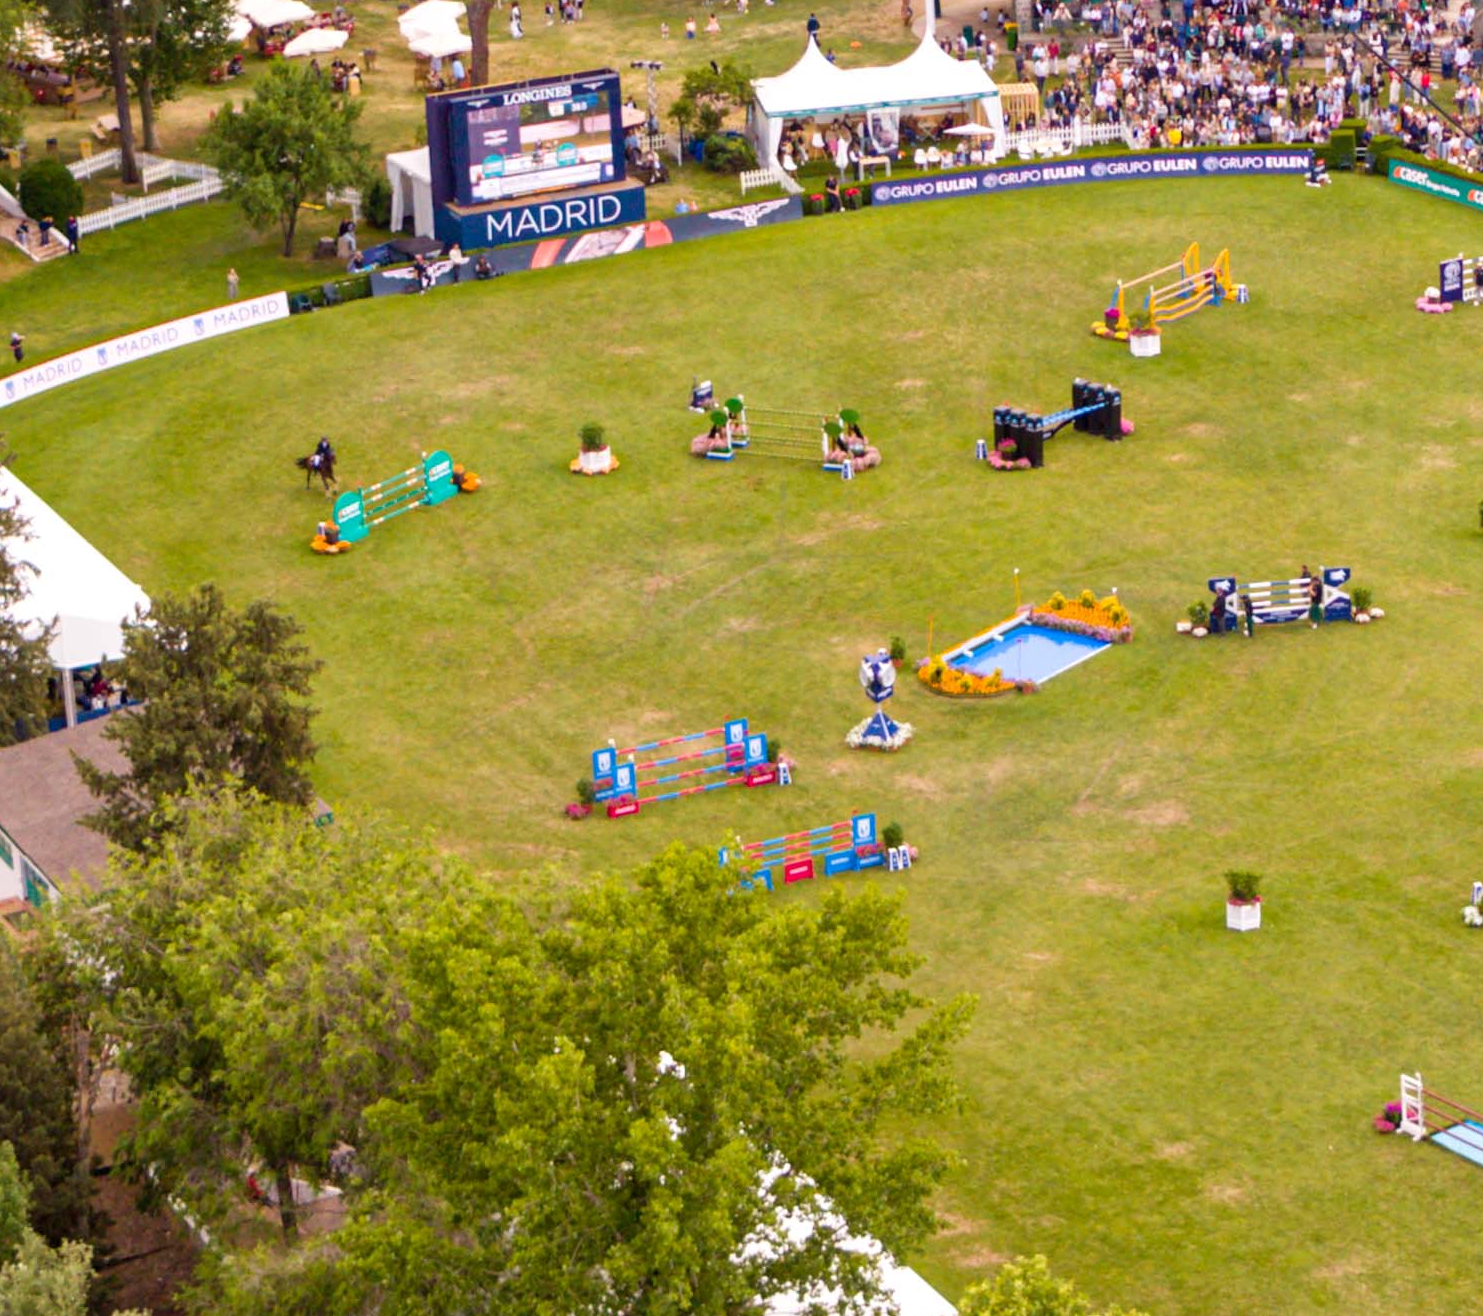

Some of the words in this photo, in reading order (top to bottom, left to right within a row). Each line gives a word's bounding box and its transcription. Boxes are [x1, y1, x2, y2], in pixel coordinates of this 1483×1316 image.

[503, 85, 572, 106] LONGINES
[1107, 160, 1151, 175] GRUPO
[1153, 158, 1197, 172] EULEN
[1219, 156, 1263, 170] GRUPO
[1265, 155, 1309, 169] EULEN
[997, 169, 1041, 185] GRUPO
[1042, 164, 1085, 180] EULEN
[891, 182, 934, 198] GRUPO
[936, 177, 977, 193] EULEN
[486, 195, 622, 241] MADRID
[213, 299, 279, 329] MADRID
[116, 327, 179, 357] MADRID
[23, 358, 83, 389] MADRID
